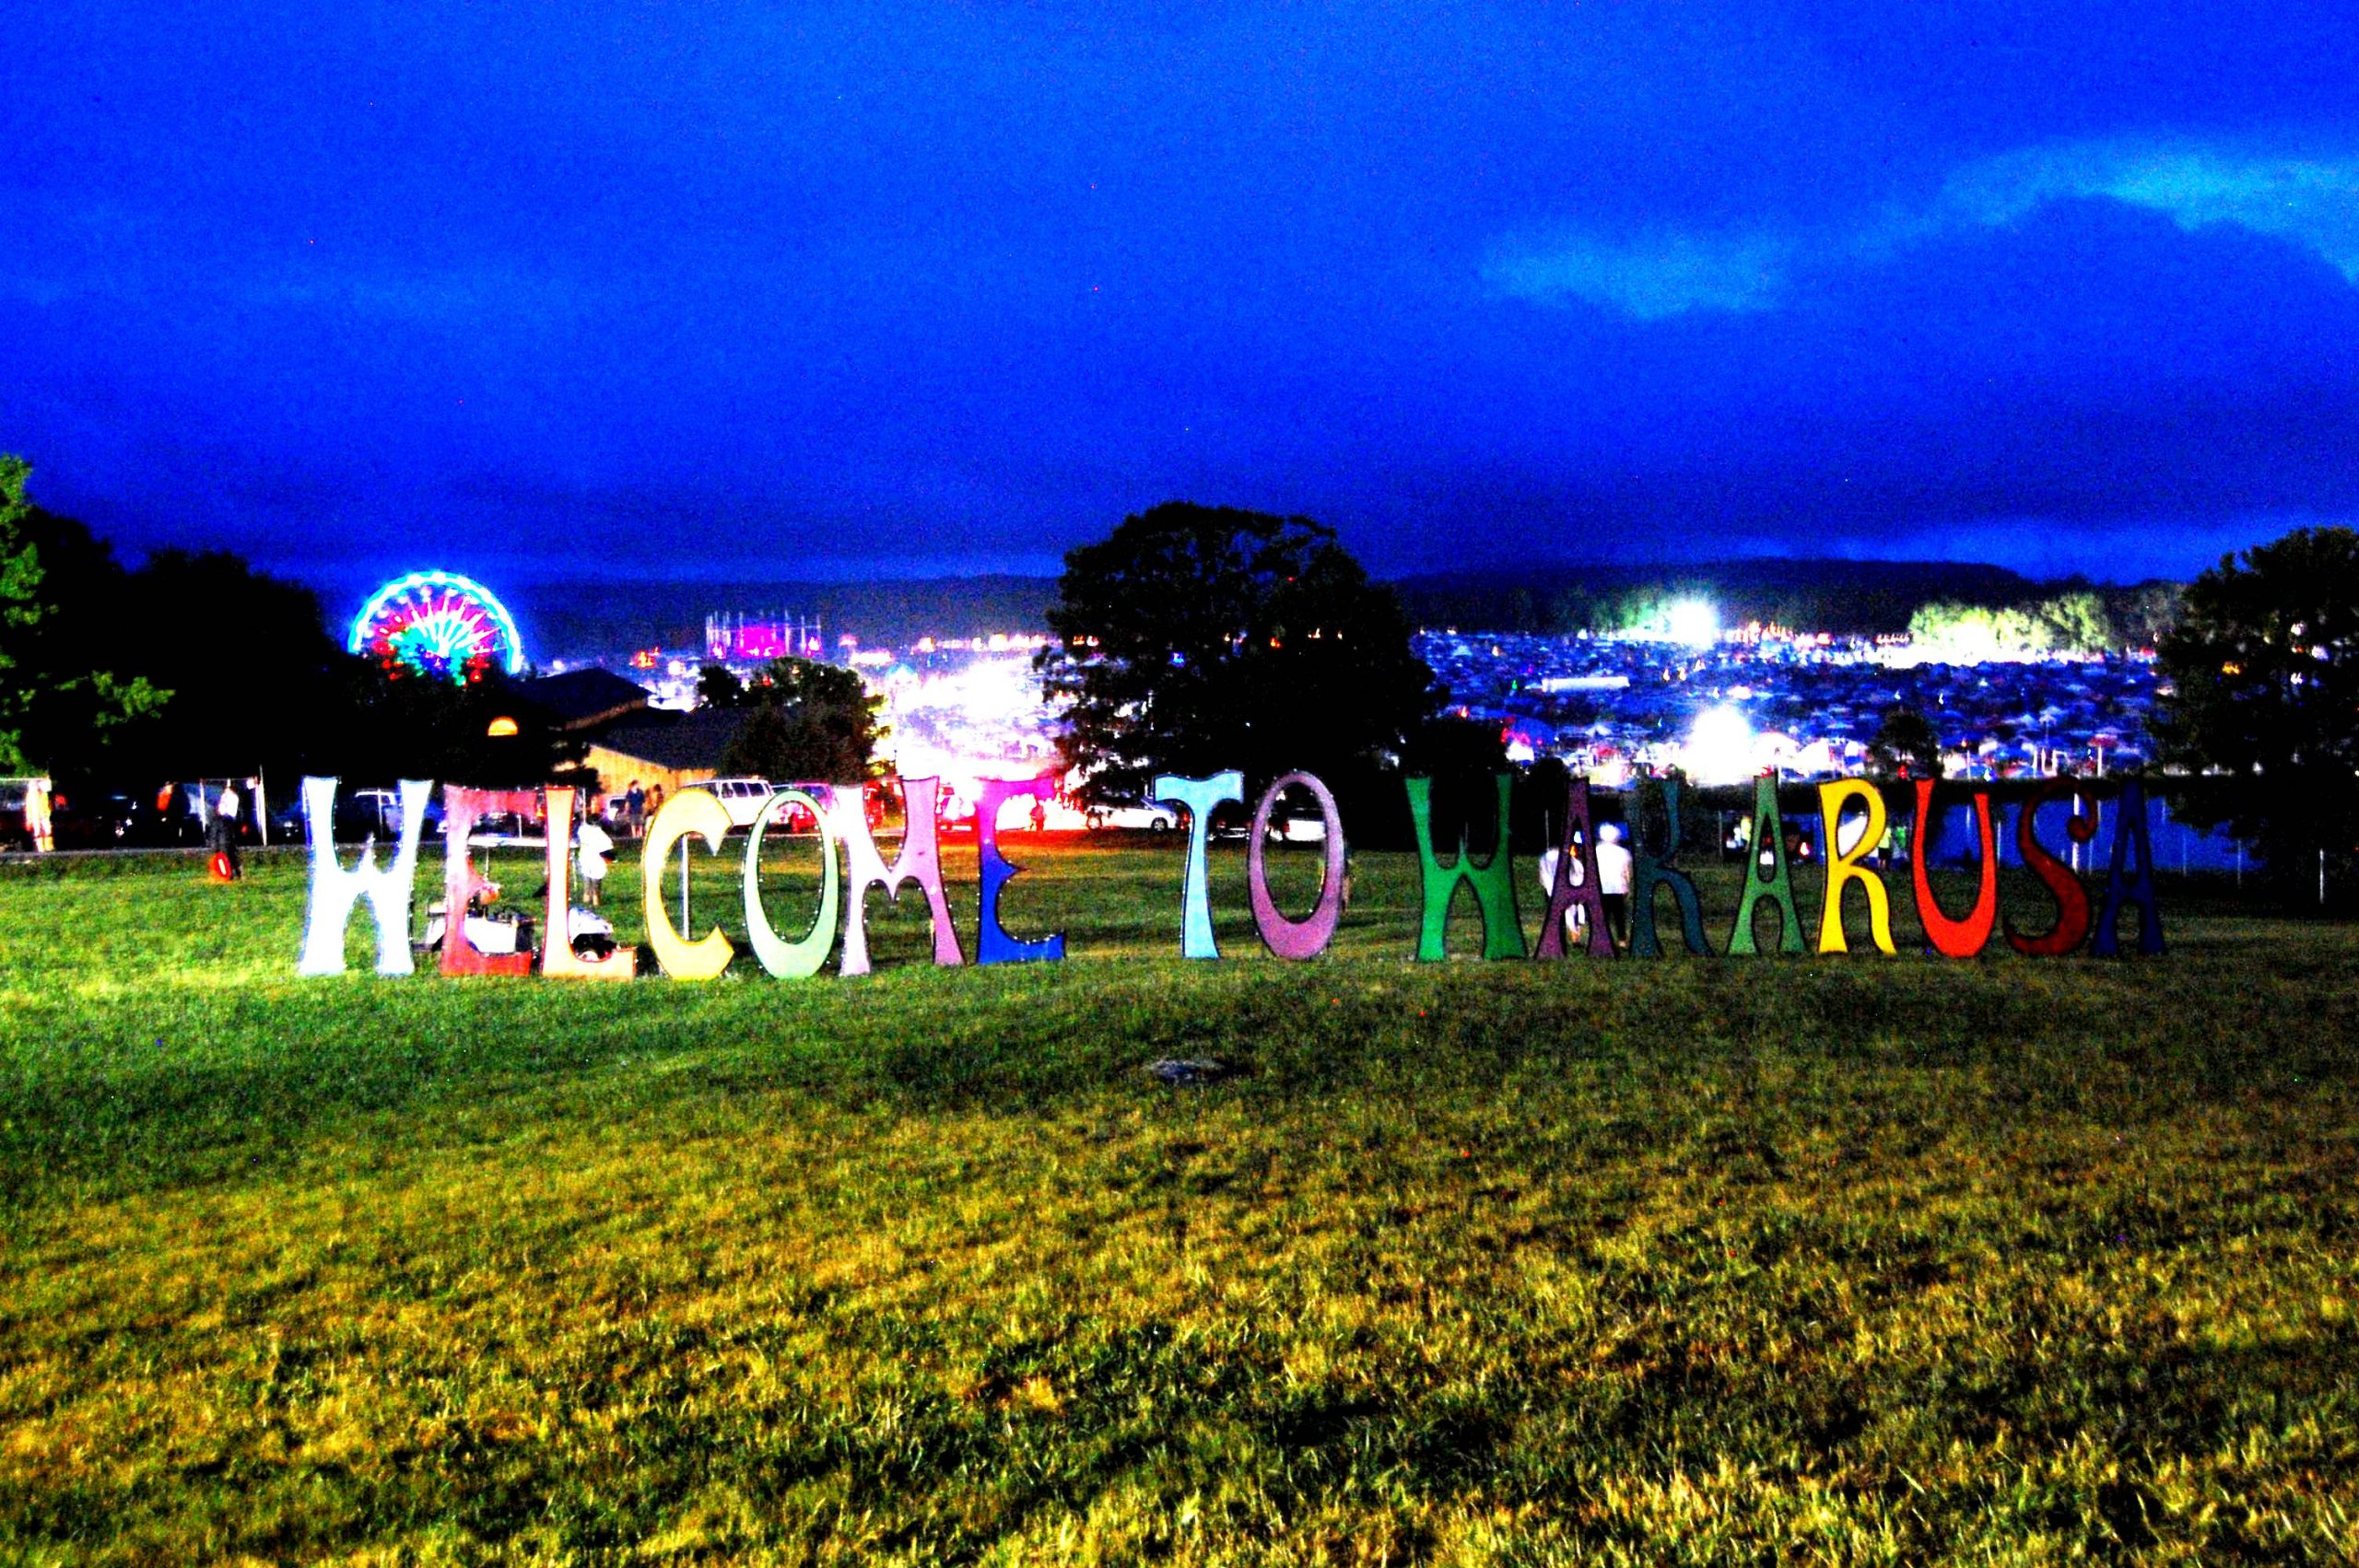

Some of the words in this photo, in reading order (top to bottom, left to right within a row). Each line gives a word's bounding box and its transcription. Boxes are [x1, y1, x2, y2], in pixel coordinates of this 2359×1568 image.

[298, 776, 1066, 980] WELCOME
[1153, 770, 1344, 960] TO
[1404, 774, 2166, 962] WAKARUSA
